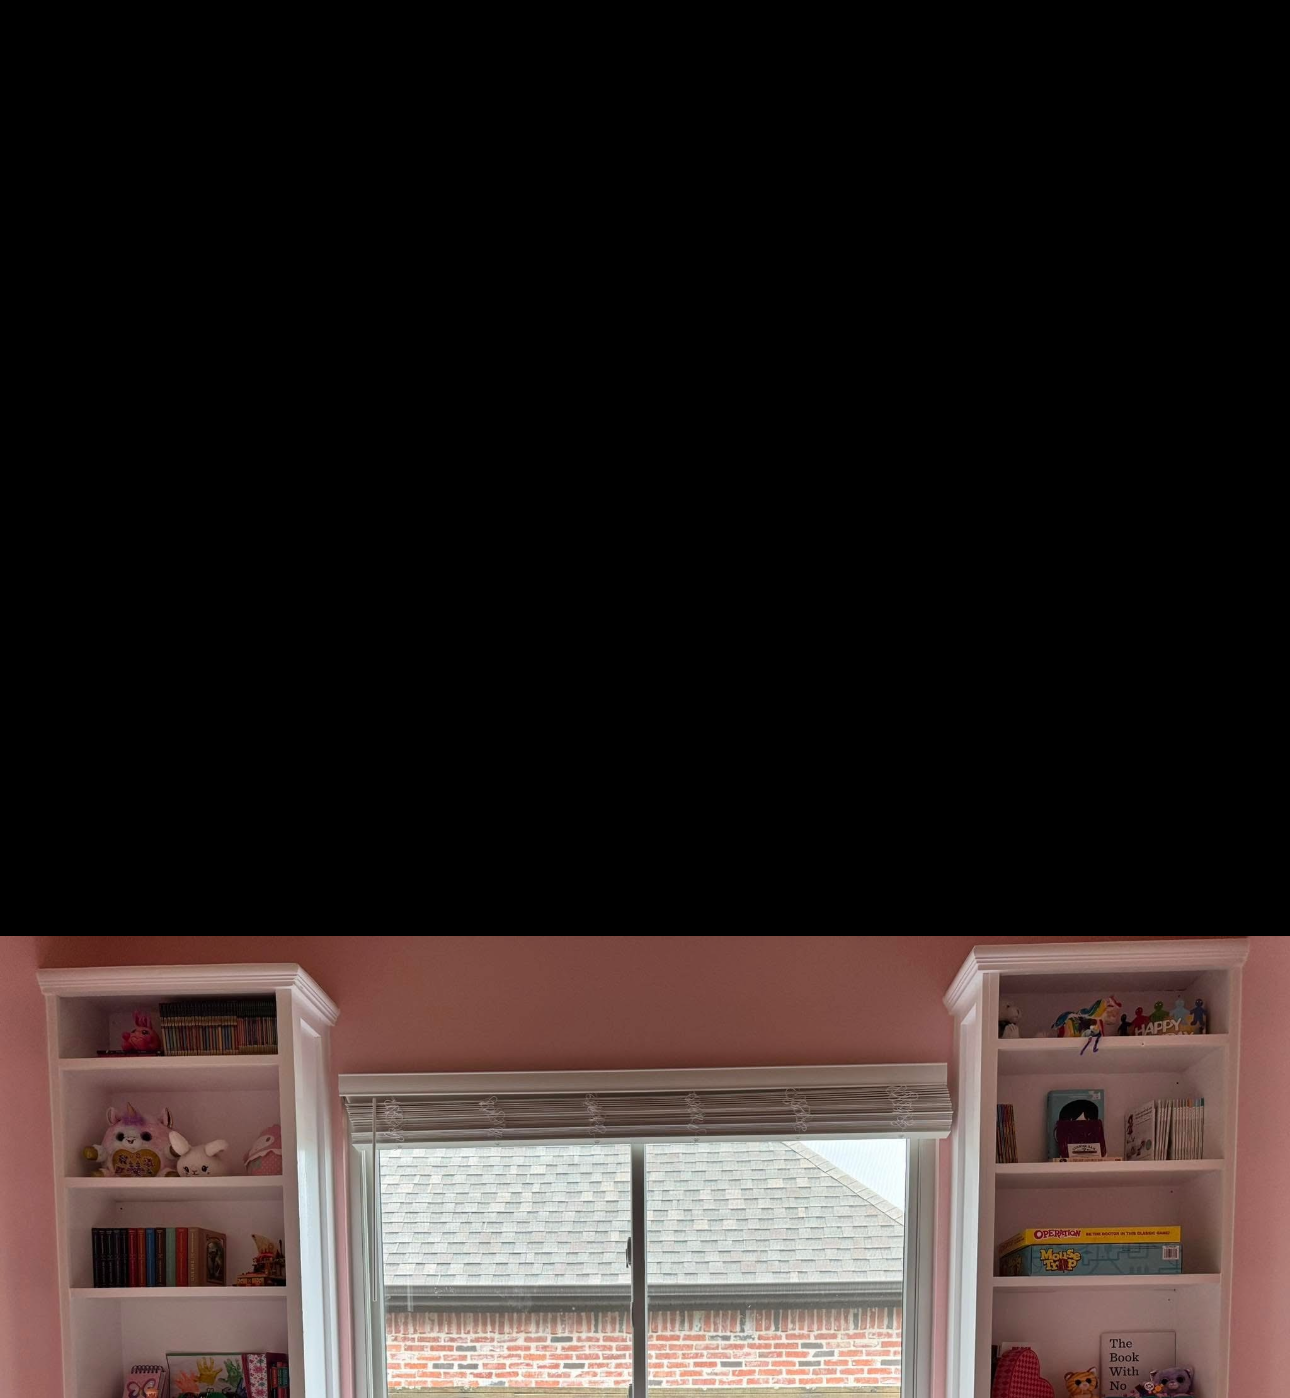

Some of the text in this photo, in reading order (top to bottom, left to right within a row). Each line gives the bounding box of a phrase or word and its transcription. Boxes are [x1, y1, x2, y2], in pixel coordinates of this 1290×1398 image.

[1134, 1018, 1182, 1036] HAPPY
[1033, 1229, 1081, 1240] OPERATION
[1040, 1248, 1081, 1260] Mouse
[1109, 1338, 1132, 1348] The
[1109, 1352, 1140, 1362] Book
[1109, 1366, 1140, 1377] With
[1109, 1381, 1127, 1391] No
